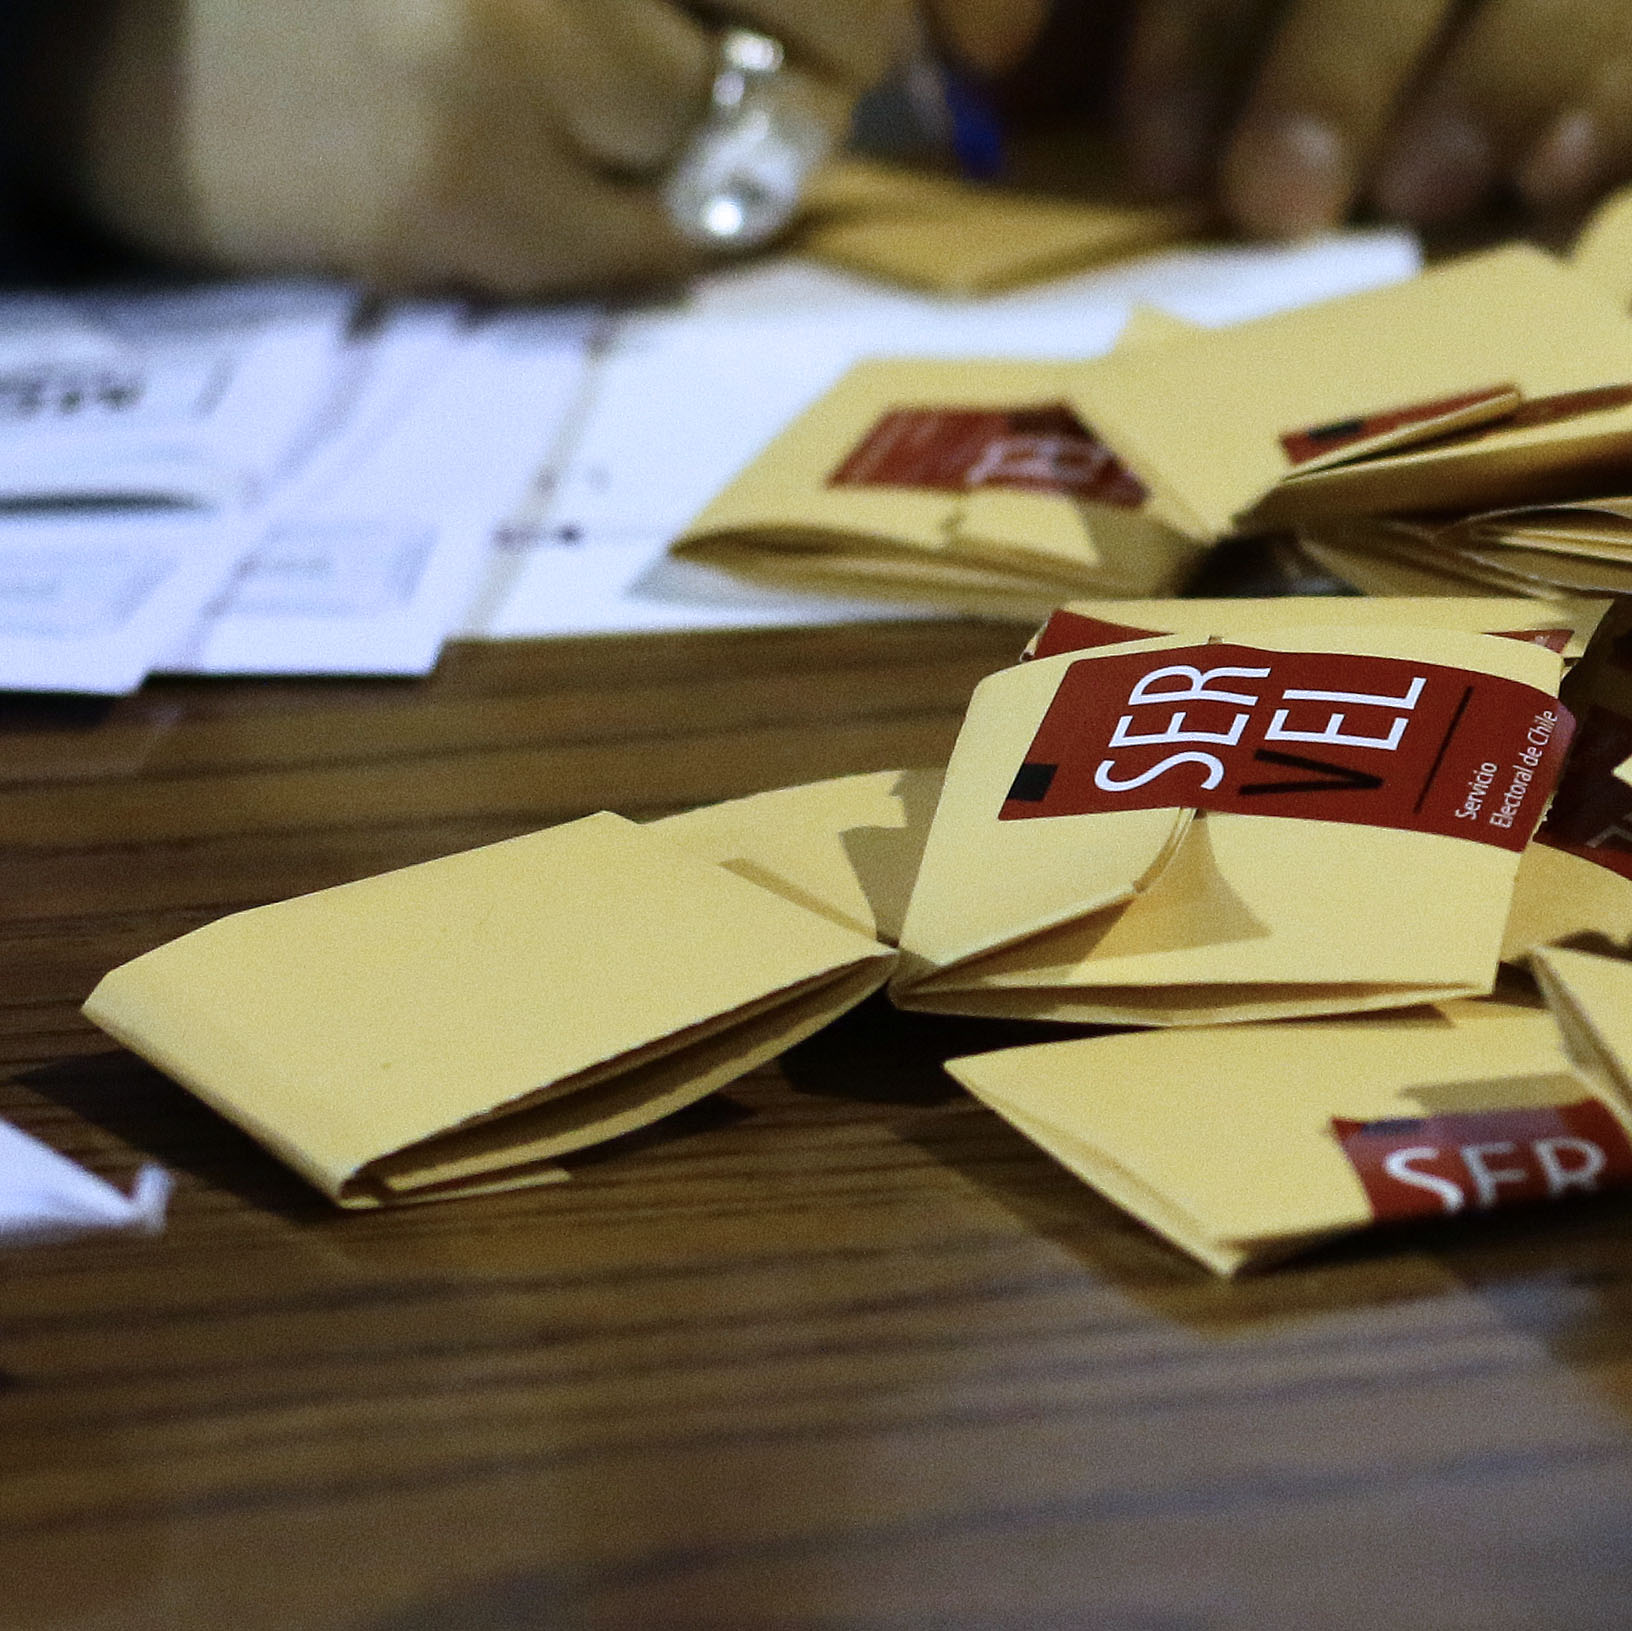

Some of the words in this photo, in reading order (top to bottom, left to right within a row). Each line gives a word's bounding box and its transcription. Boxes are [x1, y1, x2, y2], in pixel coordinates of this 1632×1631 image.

[1094, 664, 1272, 793] SER
[1238, 676, 1428, 797] VEL
[1518, 745, 1543, 767] de
[1526, 709, 1558, 746] Chile
[1454, 761, 1499, 821] Servicio
[1488, 764, 1535, 829] Electoral
